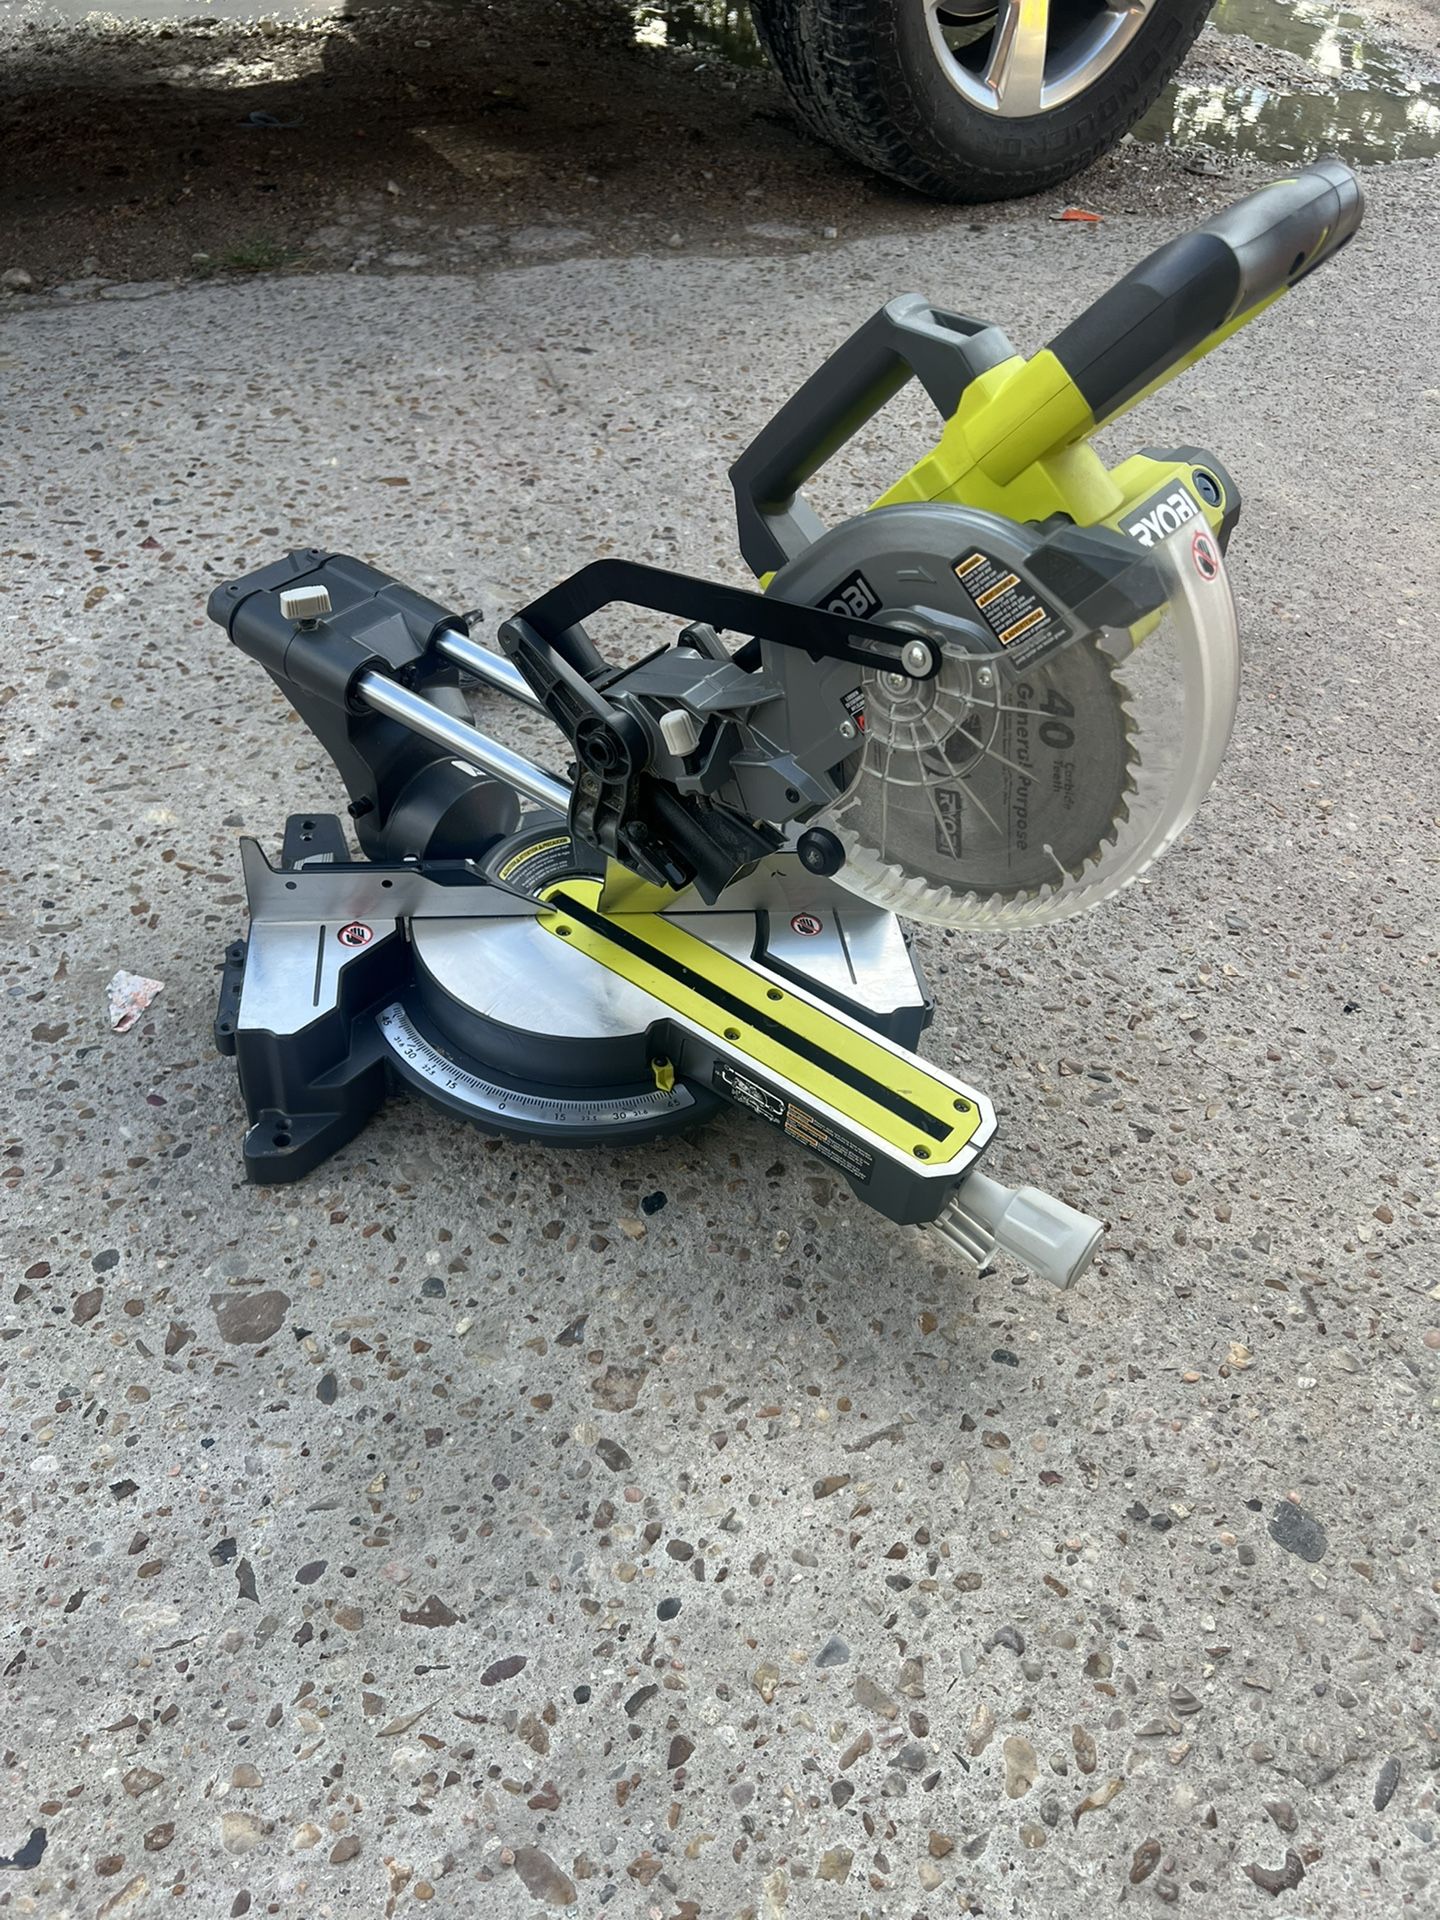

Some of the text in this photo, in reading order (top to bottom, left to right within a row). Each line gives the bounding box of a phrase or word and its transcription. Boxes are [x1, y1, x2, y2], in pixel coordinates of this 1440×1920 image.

[1128, 487, 1199, 548] RYOBI
[828, 577, 877, 617] OBI
[1039, 688, 1076, 750] 40
[1013, 682, 1034, 850] General Purpose
[1053, 760, 1064, 793] Teeth
[1064, 761, 1076, 811] Carbide
[382, 1016, 393, 1026] 45
[404, 1049, 417, 1060] 30
[446, 1080, 458, 1090] 15
[498, 1102, 506, 1110] 0
[554, 1112, 566, 1121] 15
[612, 1112, 627, 1120] 30
[633, 1109, 648, 1117] 31.6
[667, 1099, 681, 1108] 45
